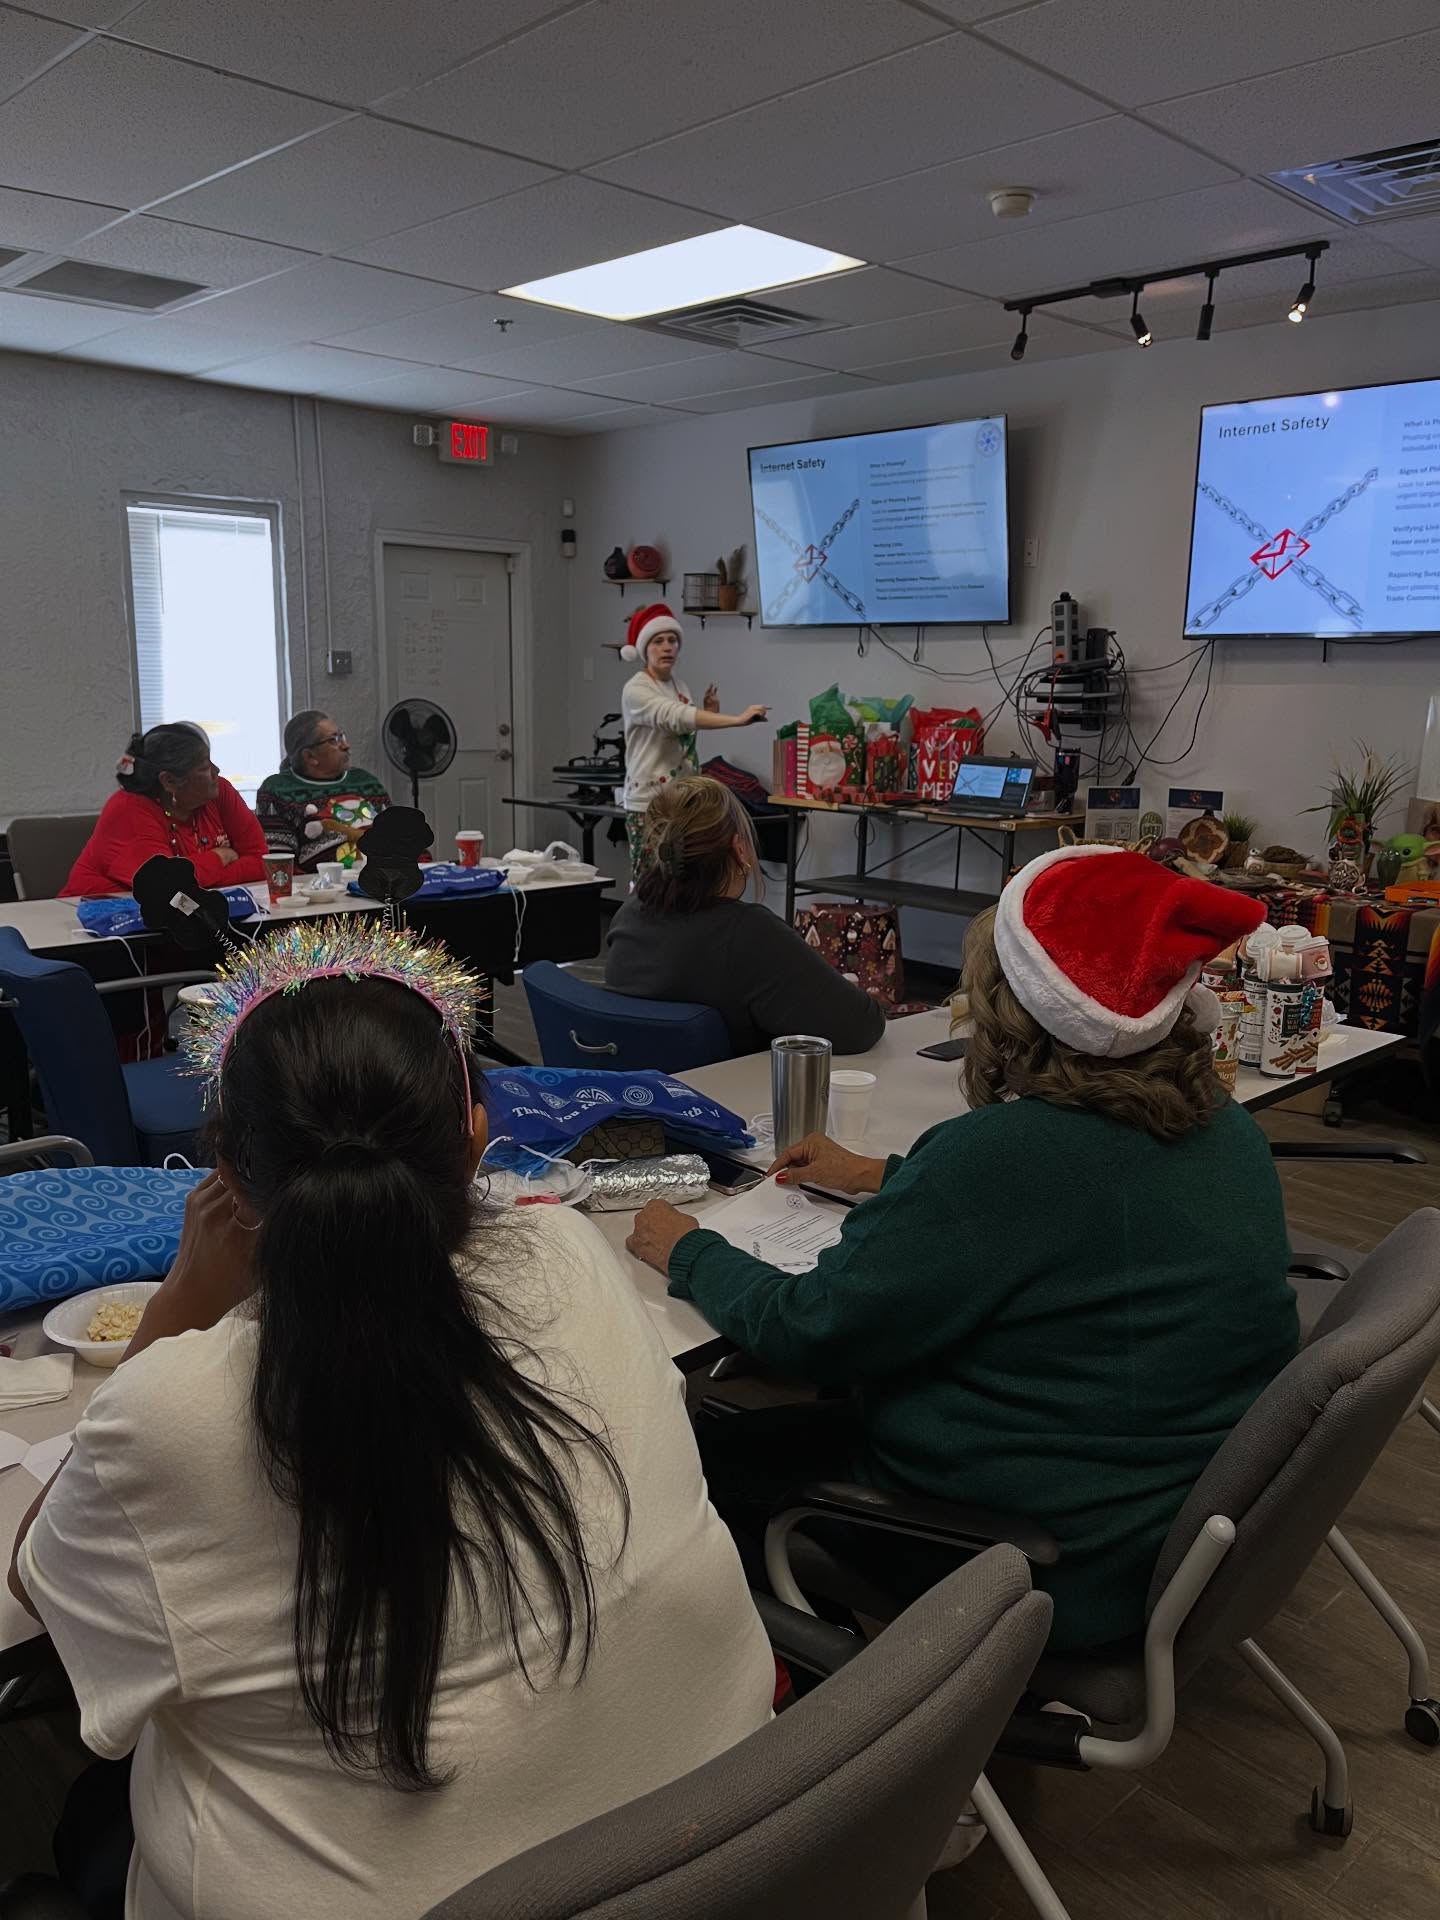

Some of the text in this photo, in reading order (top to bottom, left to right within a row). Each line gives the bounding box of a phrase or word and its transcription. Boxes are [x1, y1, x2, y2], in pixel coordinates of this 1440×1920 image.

[1219, 416, 1330, 438] Internet Safety
[451, 423, 488, 460] EXIT
[760, 458, 826, 474] Internet Safety
[923, 760, 958, 780] VER
[922, 782, 953, 801] MER
